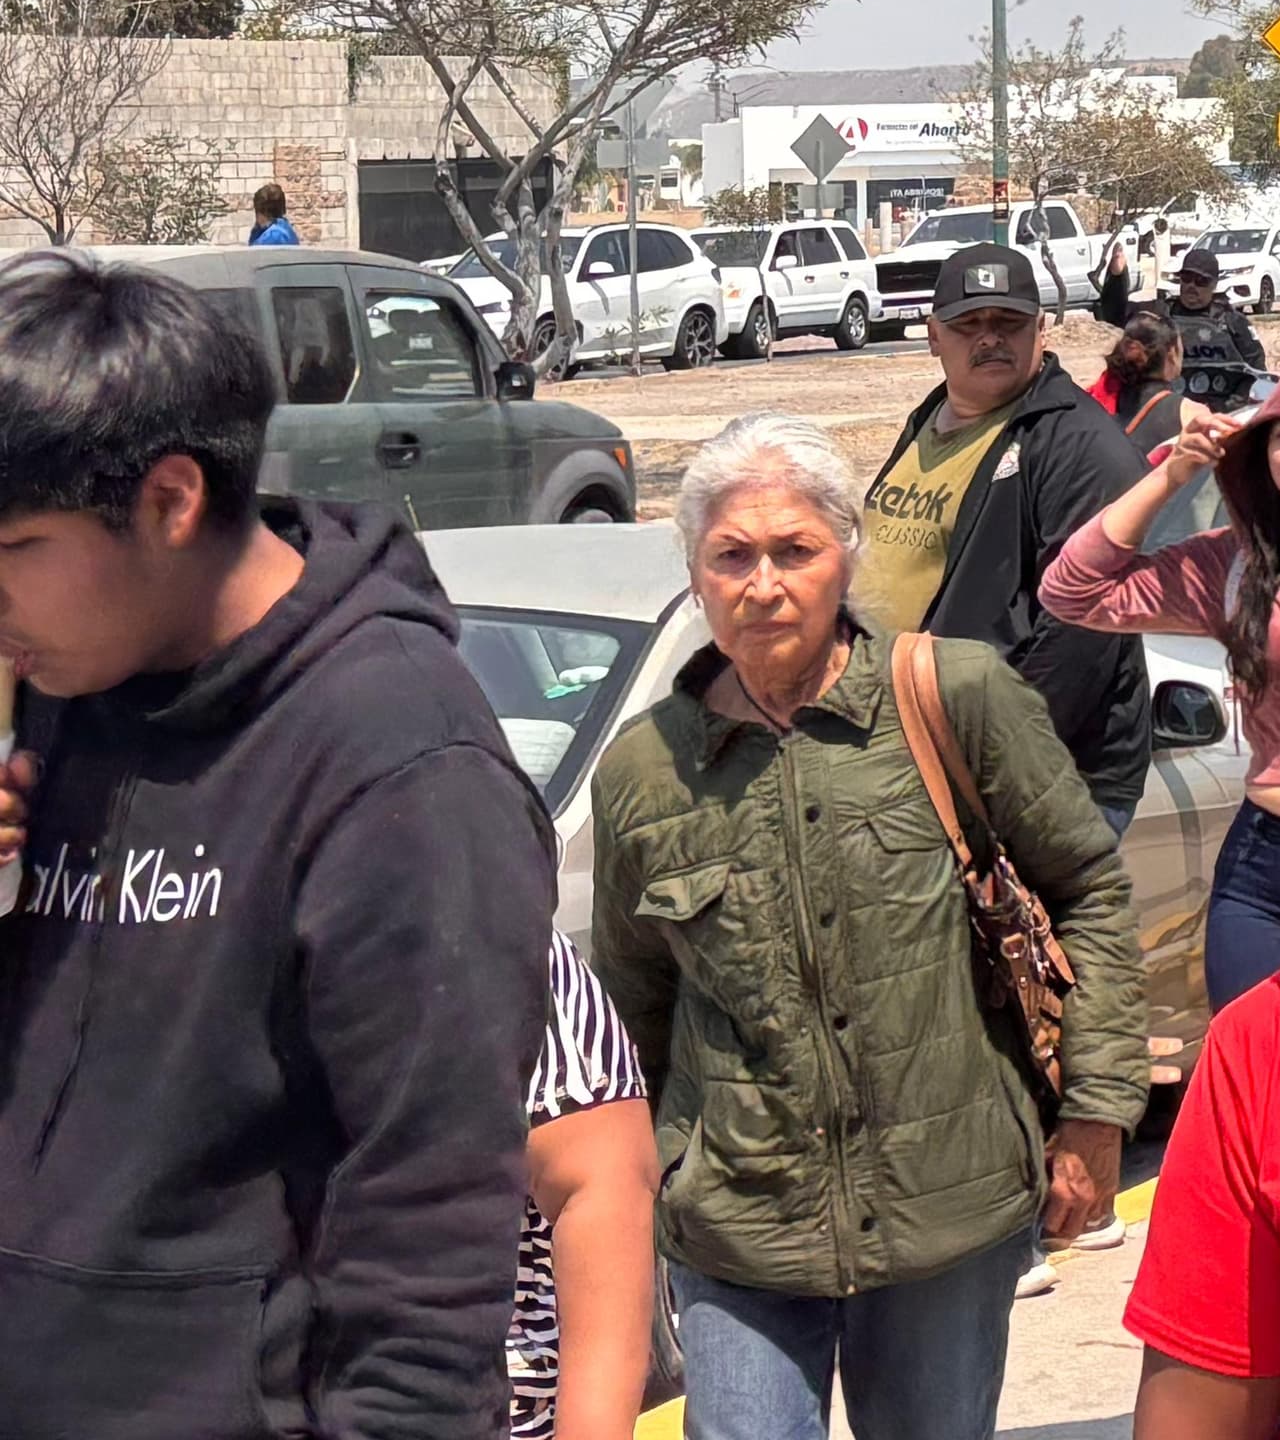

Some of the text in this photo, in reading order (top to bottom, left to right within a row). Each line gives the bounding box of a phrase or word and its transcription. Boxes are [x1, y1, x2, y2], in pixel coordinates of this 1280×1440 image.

[875, 523, 938, 551] CLASSIC
[25, 842, 224, 924] alvin Klein
